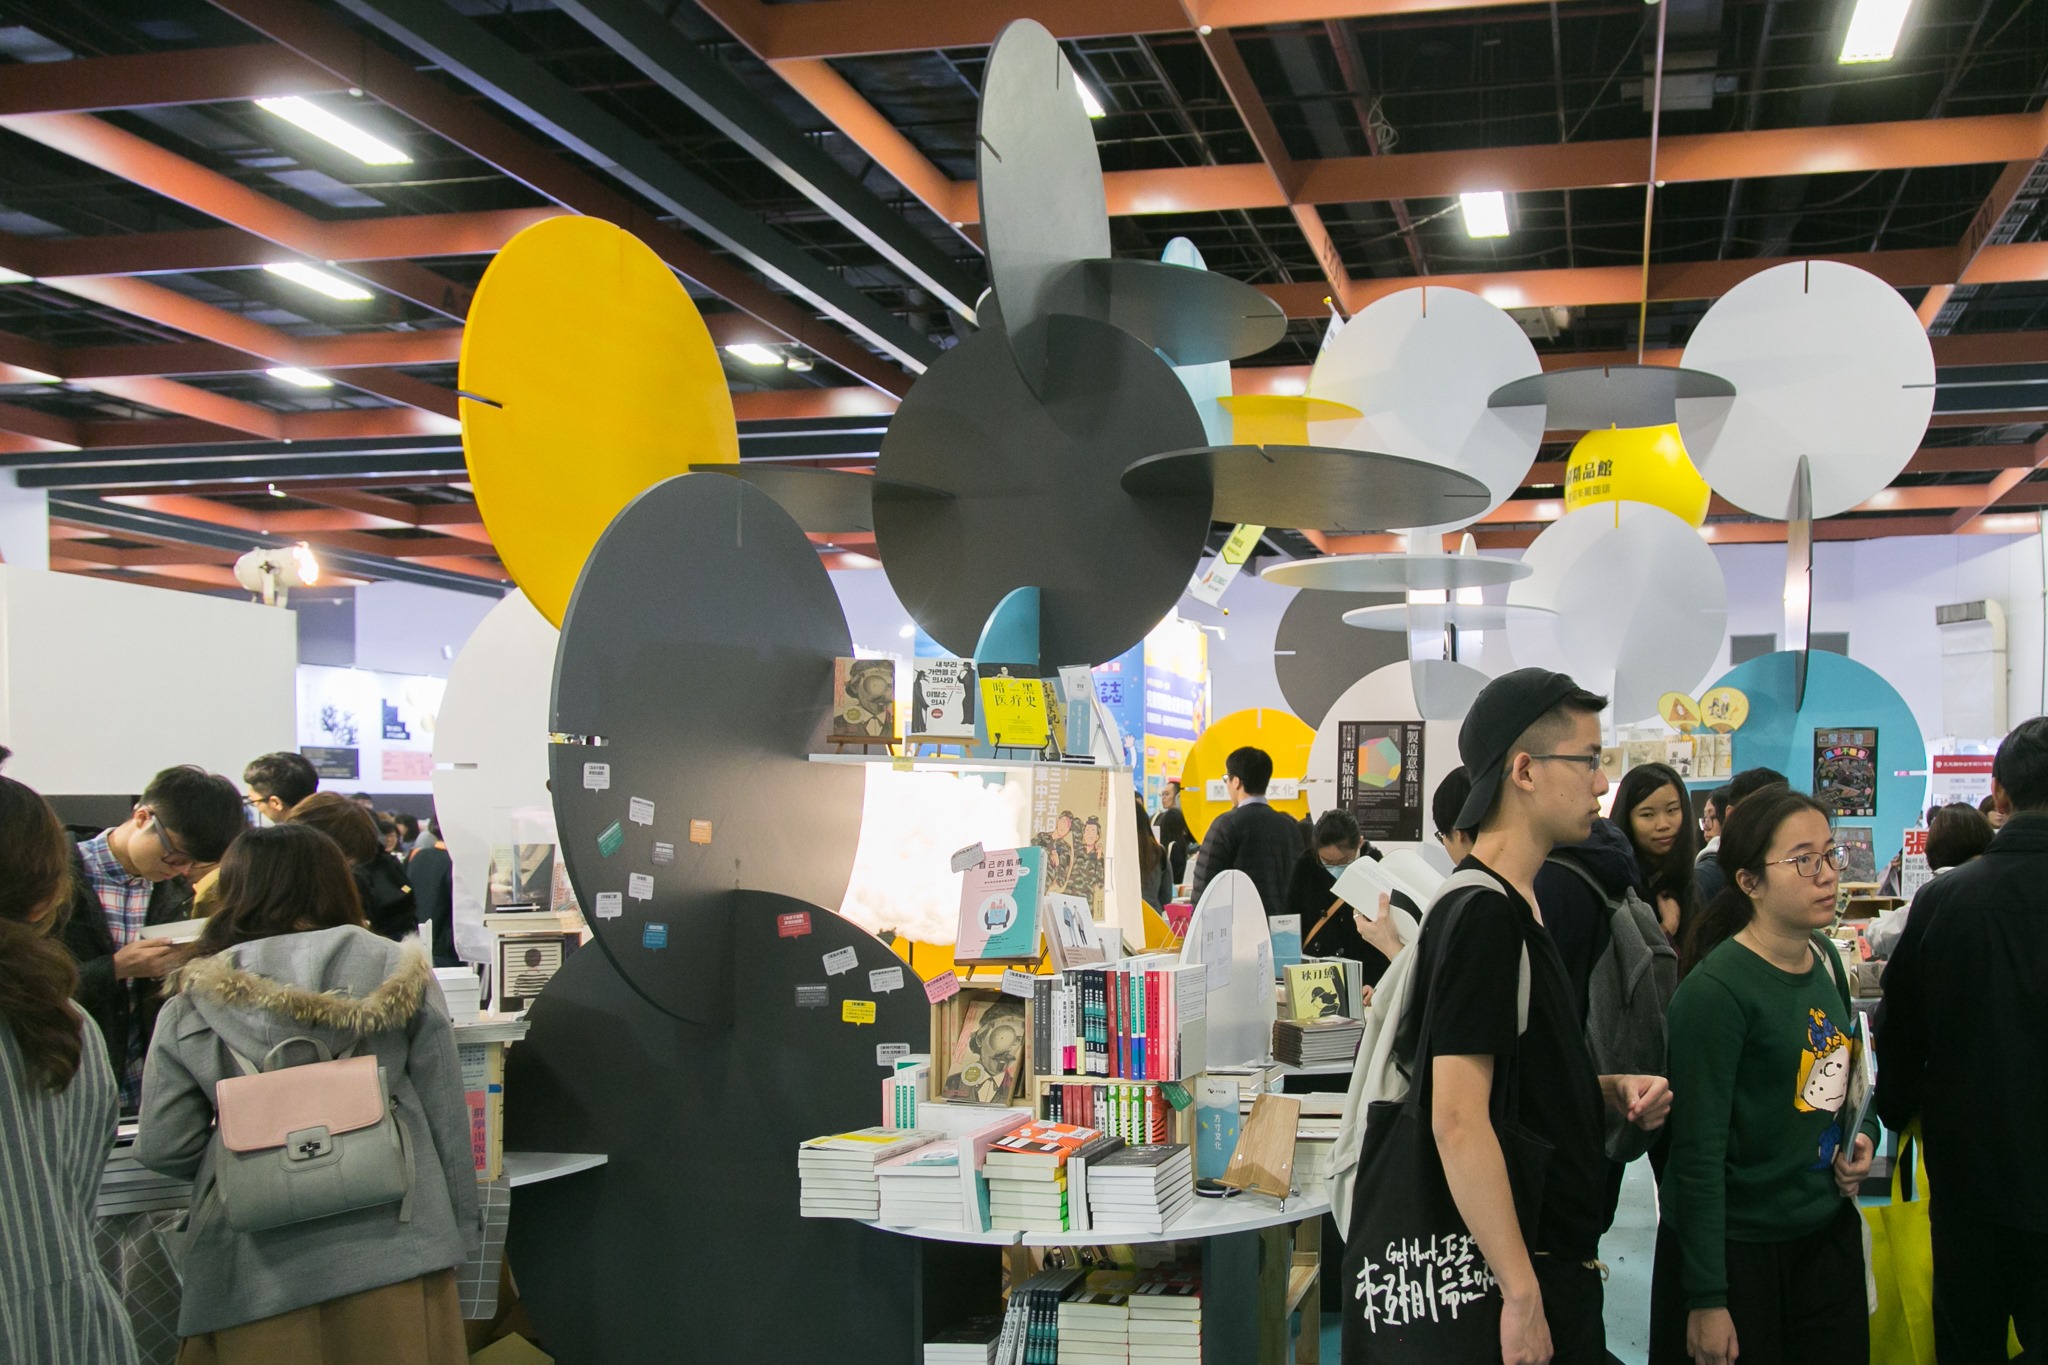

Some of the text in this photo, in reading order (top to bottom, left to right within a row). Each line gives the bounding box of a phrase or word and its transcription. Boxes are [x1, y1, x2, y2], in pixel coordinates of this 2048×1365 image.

[932, 676, 953, 684] 의사와
[925, 690, 948, 698] 이발소
[930, 698, 946, 706] 의사
[994, 694, 1037, 708] 医疗史
[1406, 731, 1419, 782] 製造意義
[979, 858, 1023, 870] 自己的肌膚
[988, 868, 1013, 878] 自己救
[1386, 1234, 1438, 1270] Get Hurt
